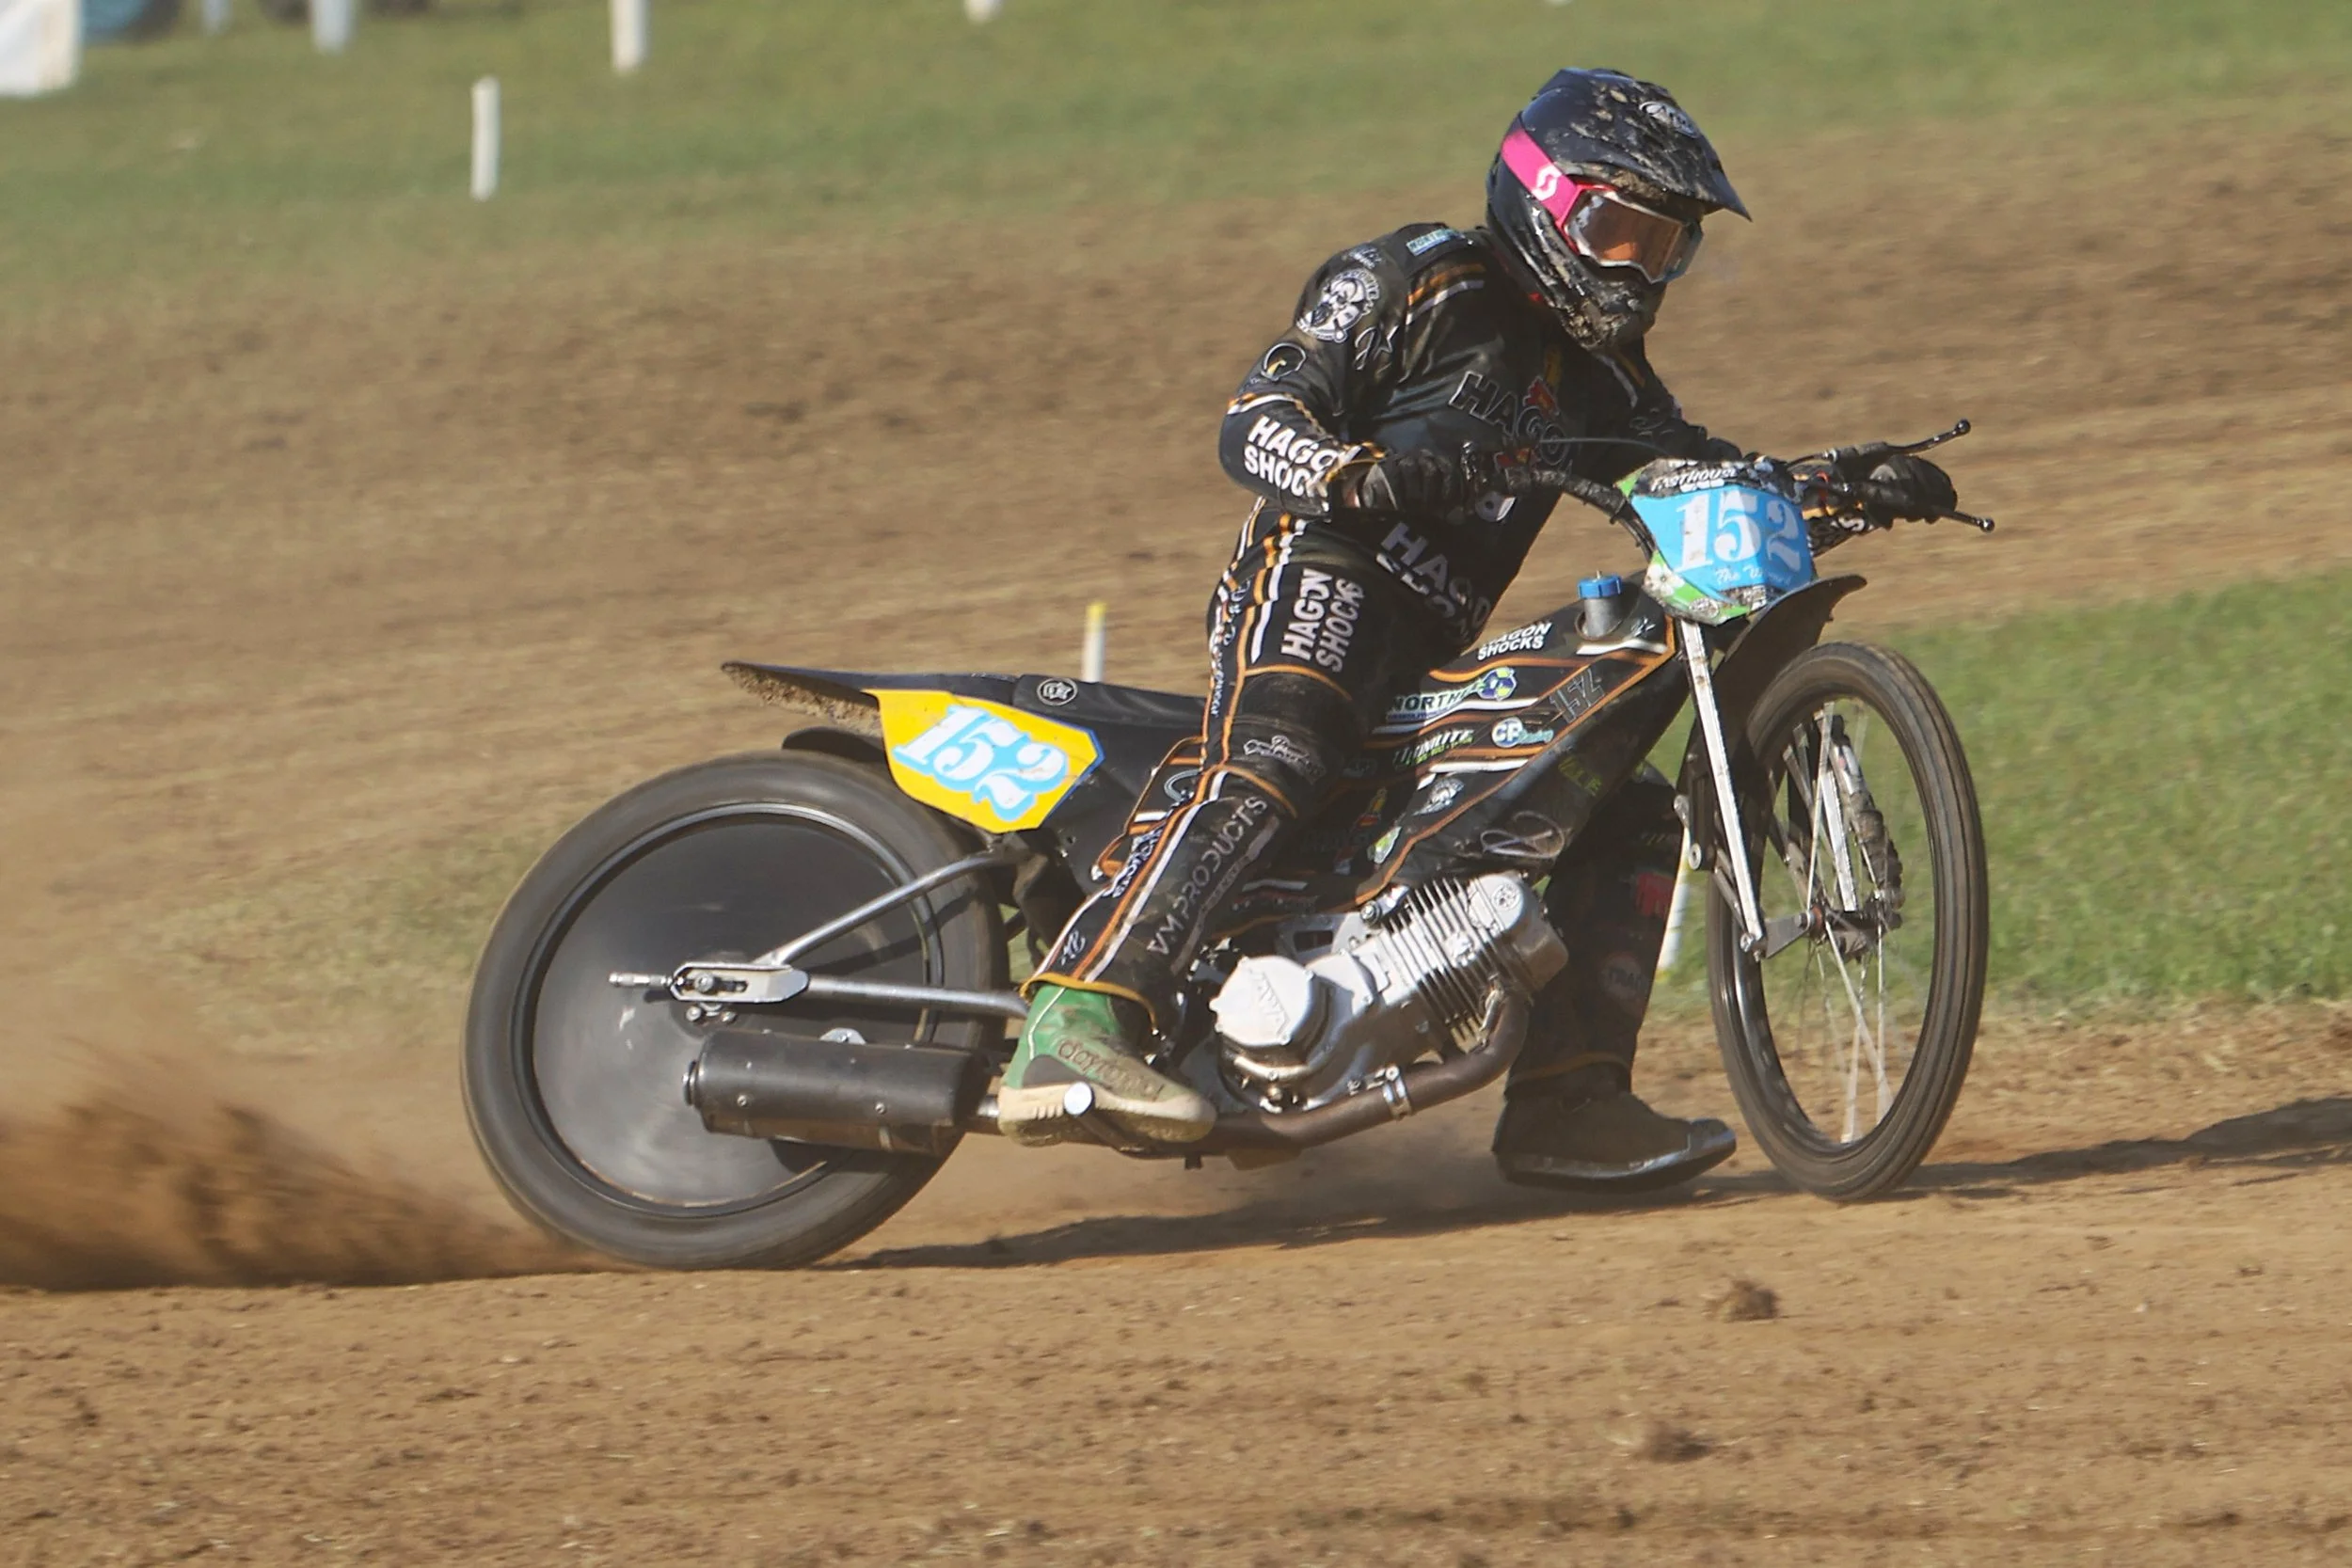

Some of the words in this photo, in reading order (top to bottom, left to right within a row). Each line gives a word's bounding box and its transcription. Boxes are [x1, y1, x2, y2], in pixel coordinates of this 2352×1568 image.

[1248, 415, 1340, 472] HAGO
[1448, 370, 1574, 474] HAGO
[1673, 489, 1802, 573] 152
[1478, 635, 1545, 660] SHOCKS
[1484, 622, 1552, 646] AGON
[894, 705, 1069, 822] 152
